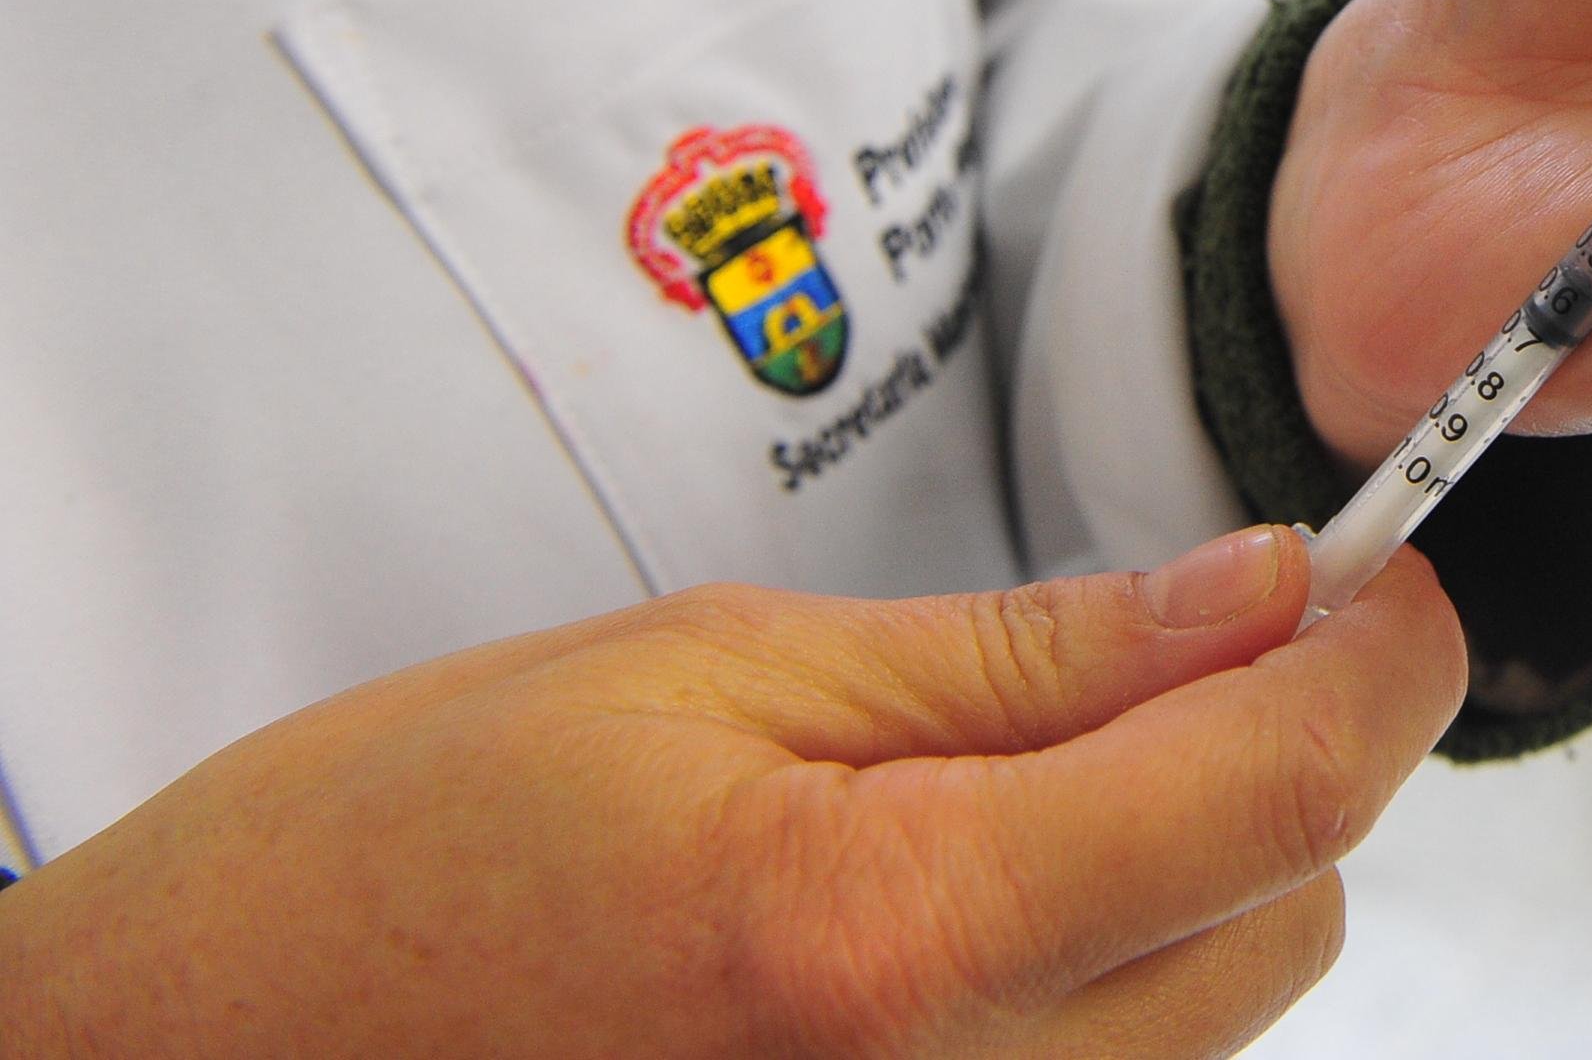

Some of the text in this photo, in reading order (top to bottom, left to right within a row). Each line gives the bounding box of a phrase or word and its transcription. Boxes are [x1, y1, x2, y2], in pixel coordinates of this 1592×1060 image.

[1538, 266, 1579, 315] 0.6
[1501, 309, 1545, 353] 0.7
[1465, 351, 1505, 400] 0.8
[1429, 392, 1468, 441] 0.9
